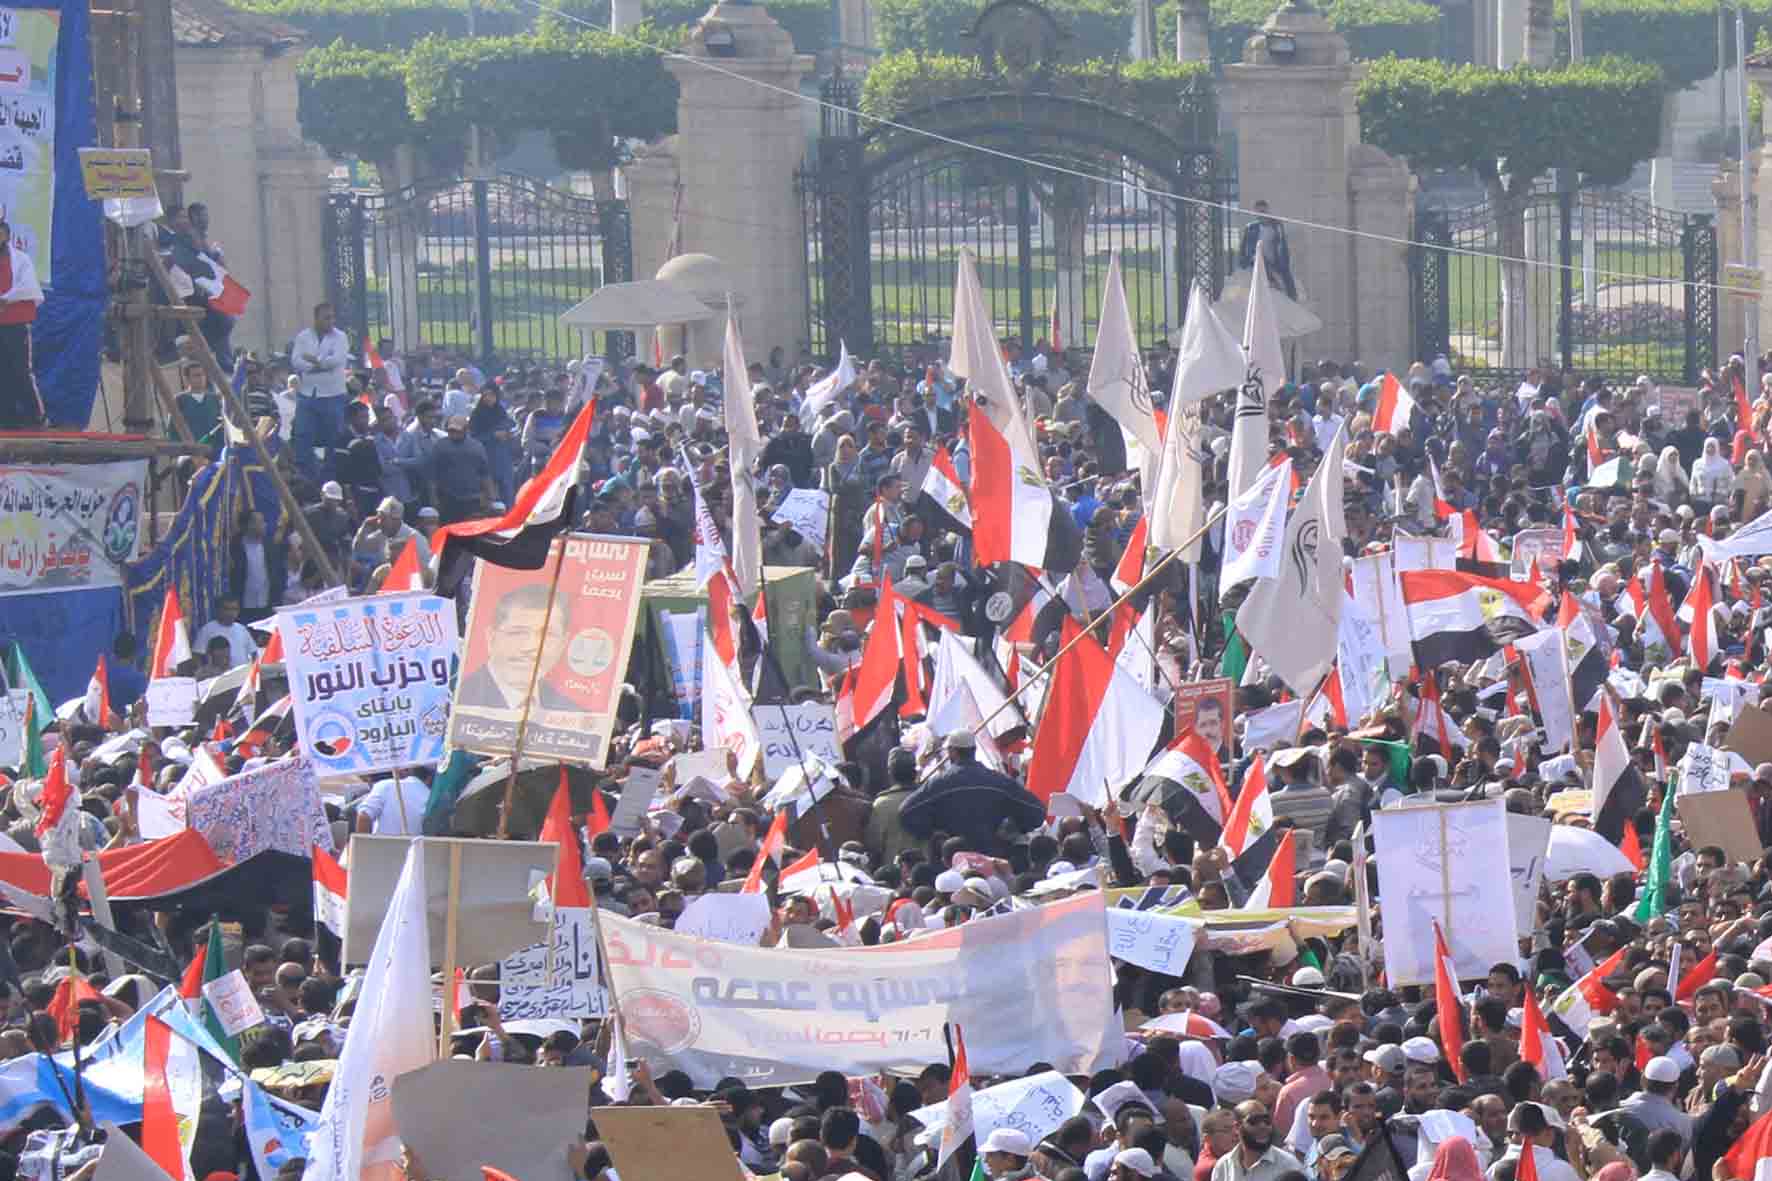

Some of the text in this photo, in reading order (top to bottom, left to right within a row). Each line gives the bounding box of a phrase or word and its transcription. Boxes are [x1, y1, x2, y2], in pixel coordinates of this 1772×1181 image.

[297, 617, 382, 662] السلفية
[306, 661, 366, 702] النور
[370, 656, 427, 692] حزب
[359, 719, 416, 744] البارود
